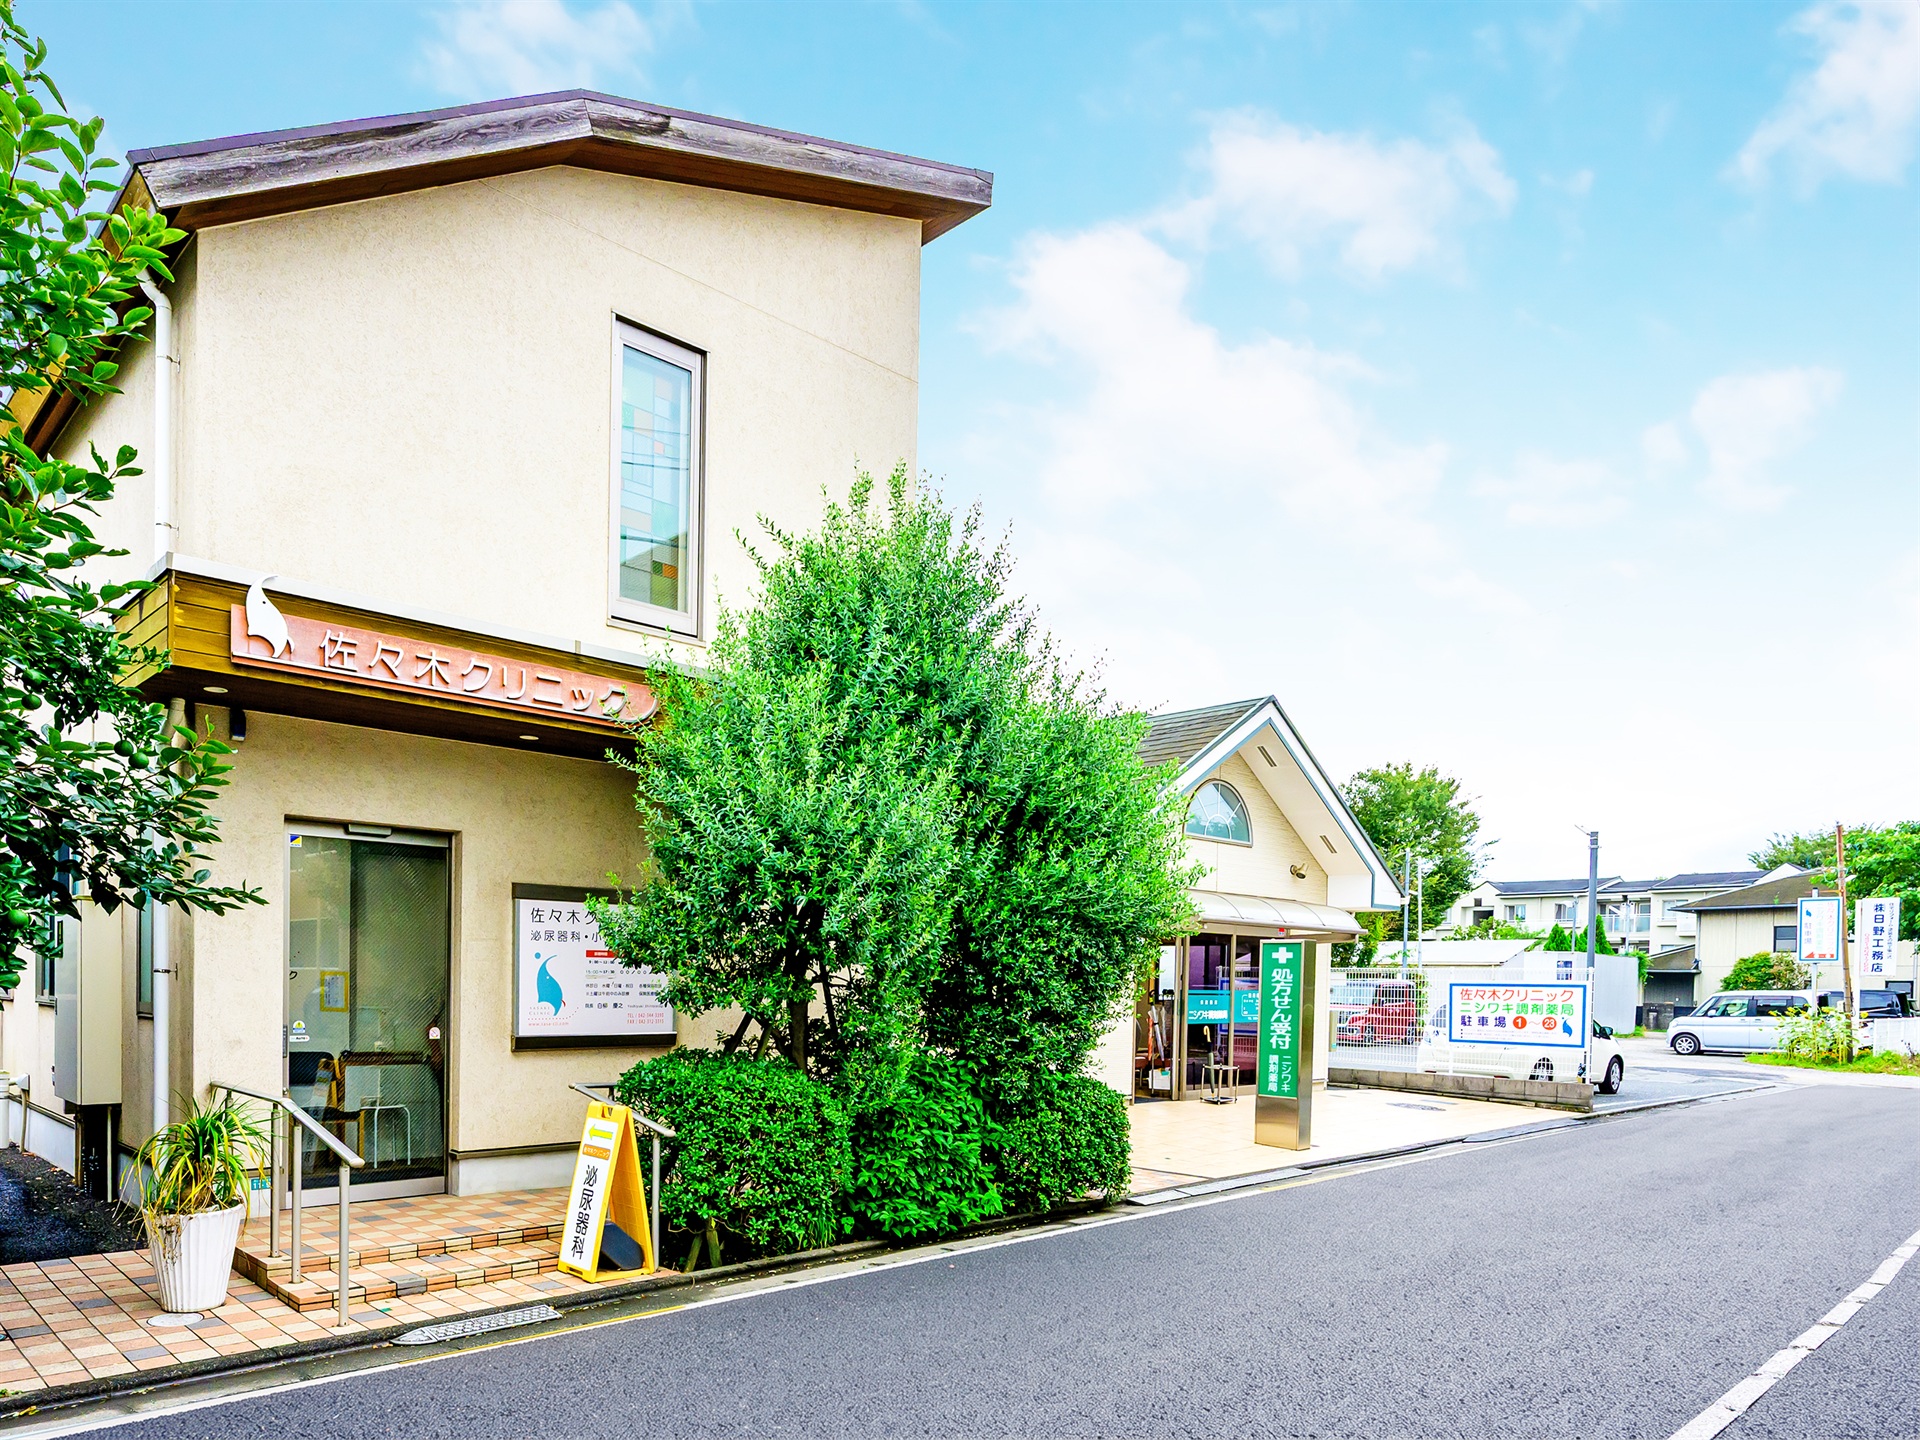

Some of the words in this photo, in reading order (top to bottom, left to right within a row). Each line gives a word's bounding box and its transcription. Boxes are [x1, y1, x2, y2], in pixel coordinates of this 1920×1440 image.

[319, 628, 628, 716] 佐々木クリニック
[1269, 968, 1293, 1050] 処方せん受付
[1460, 988, 1574, 1002] 佐々木クリニック
[1460, 1002, 1574, 1016] ニシワキ調剤薬局
[1460, 1015, 1506, 1028] 駐車場
[1281, 1055, 1292, 1093] ニシワキ
[571, 1164, 599, 1260] 泌尿器科
